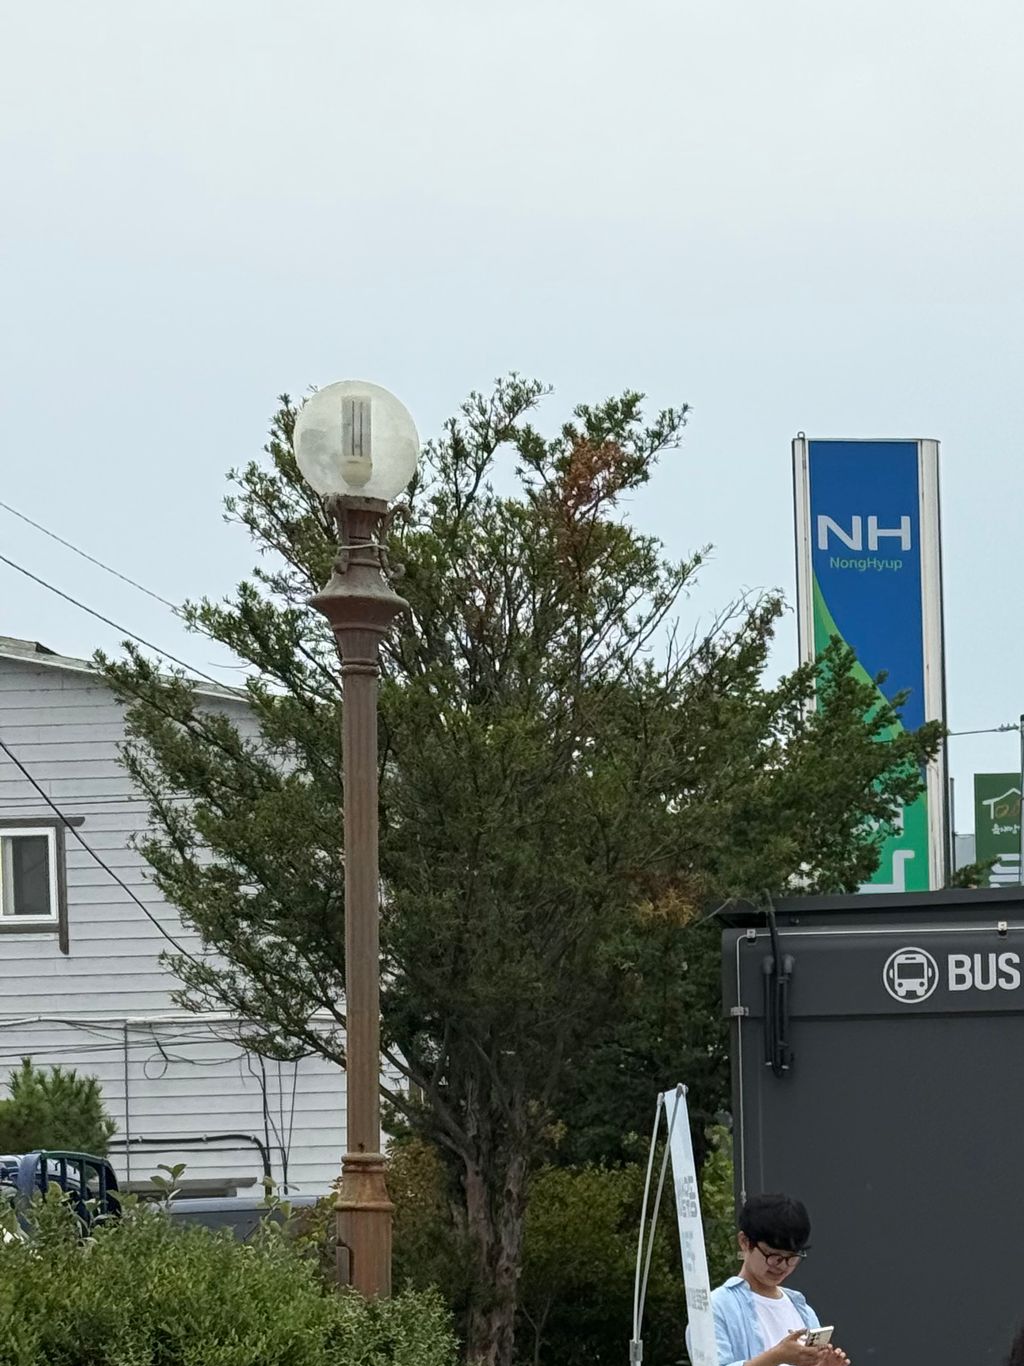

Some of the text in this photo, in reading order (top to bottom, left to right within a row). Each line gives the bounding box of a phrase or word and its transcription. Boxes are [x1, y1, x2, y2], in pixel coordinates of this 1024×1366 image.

[817, 514, 912, 551] NH
[830, 556, 903, 572] NongHyup
[947, 952, 1021, 992] BUS
